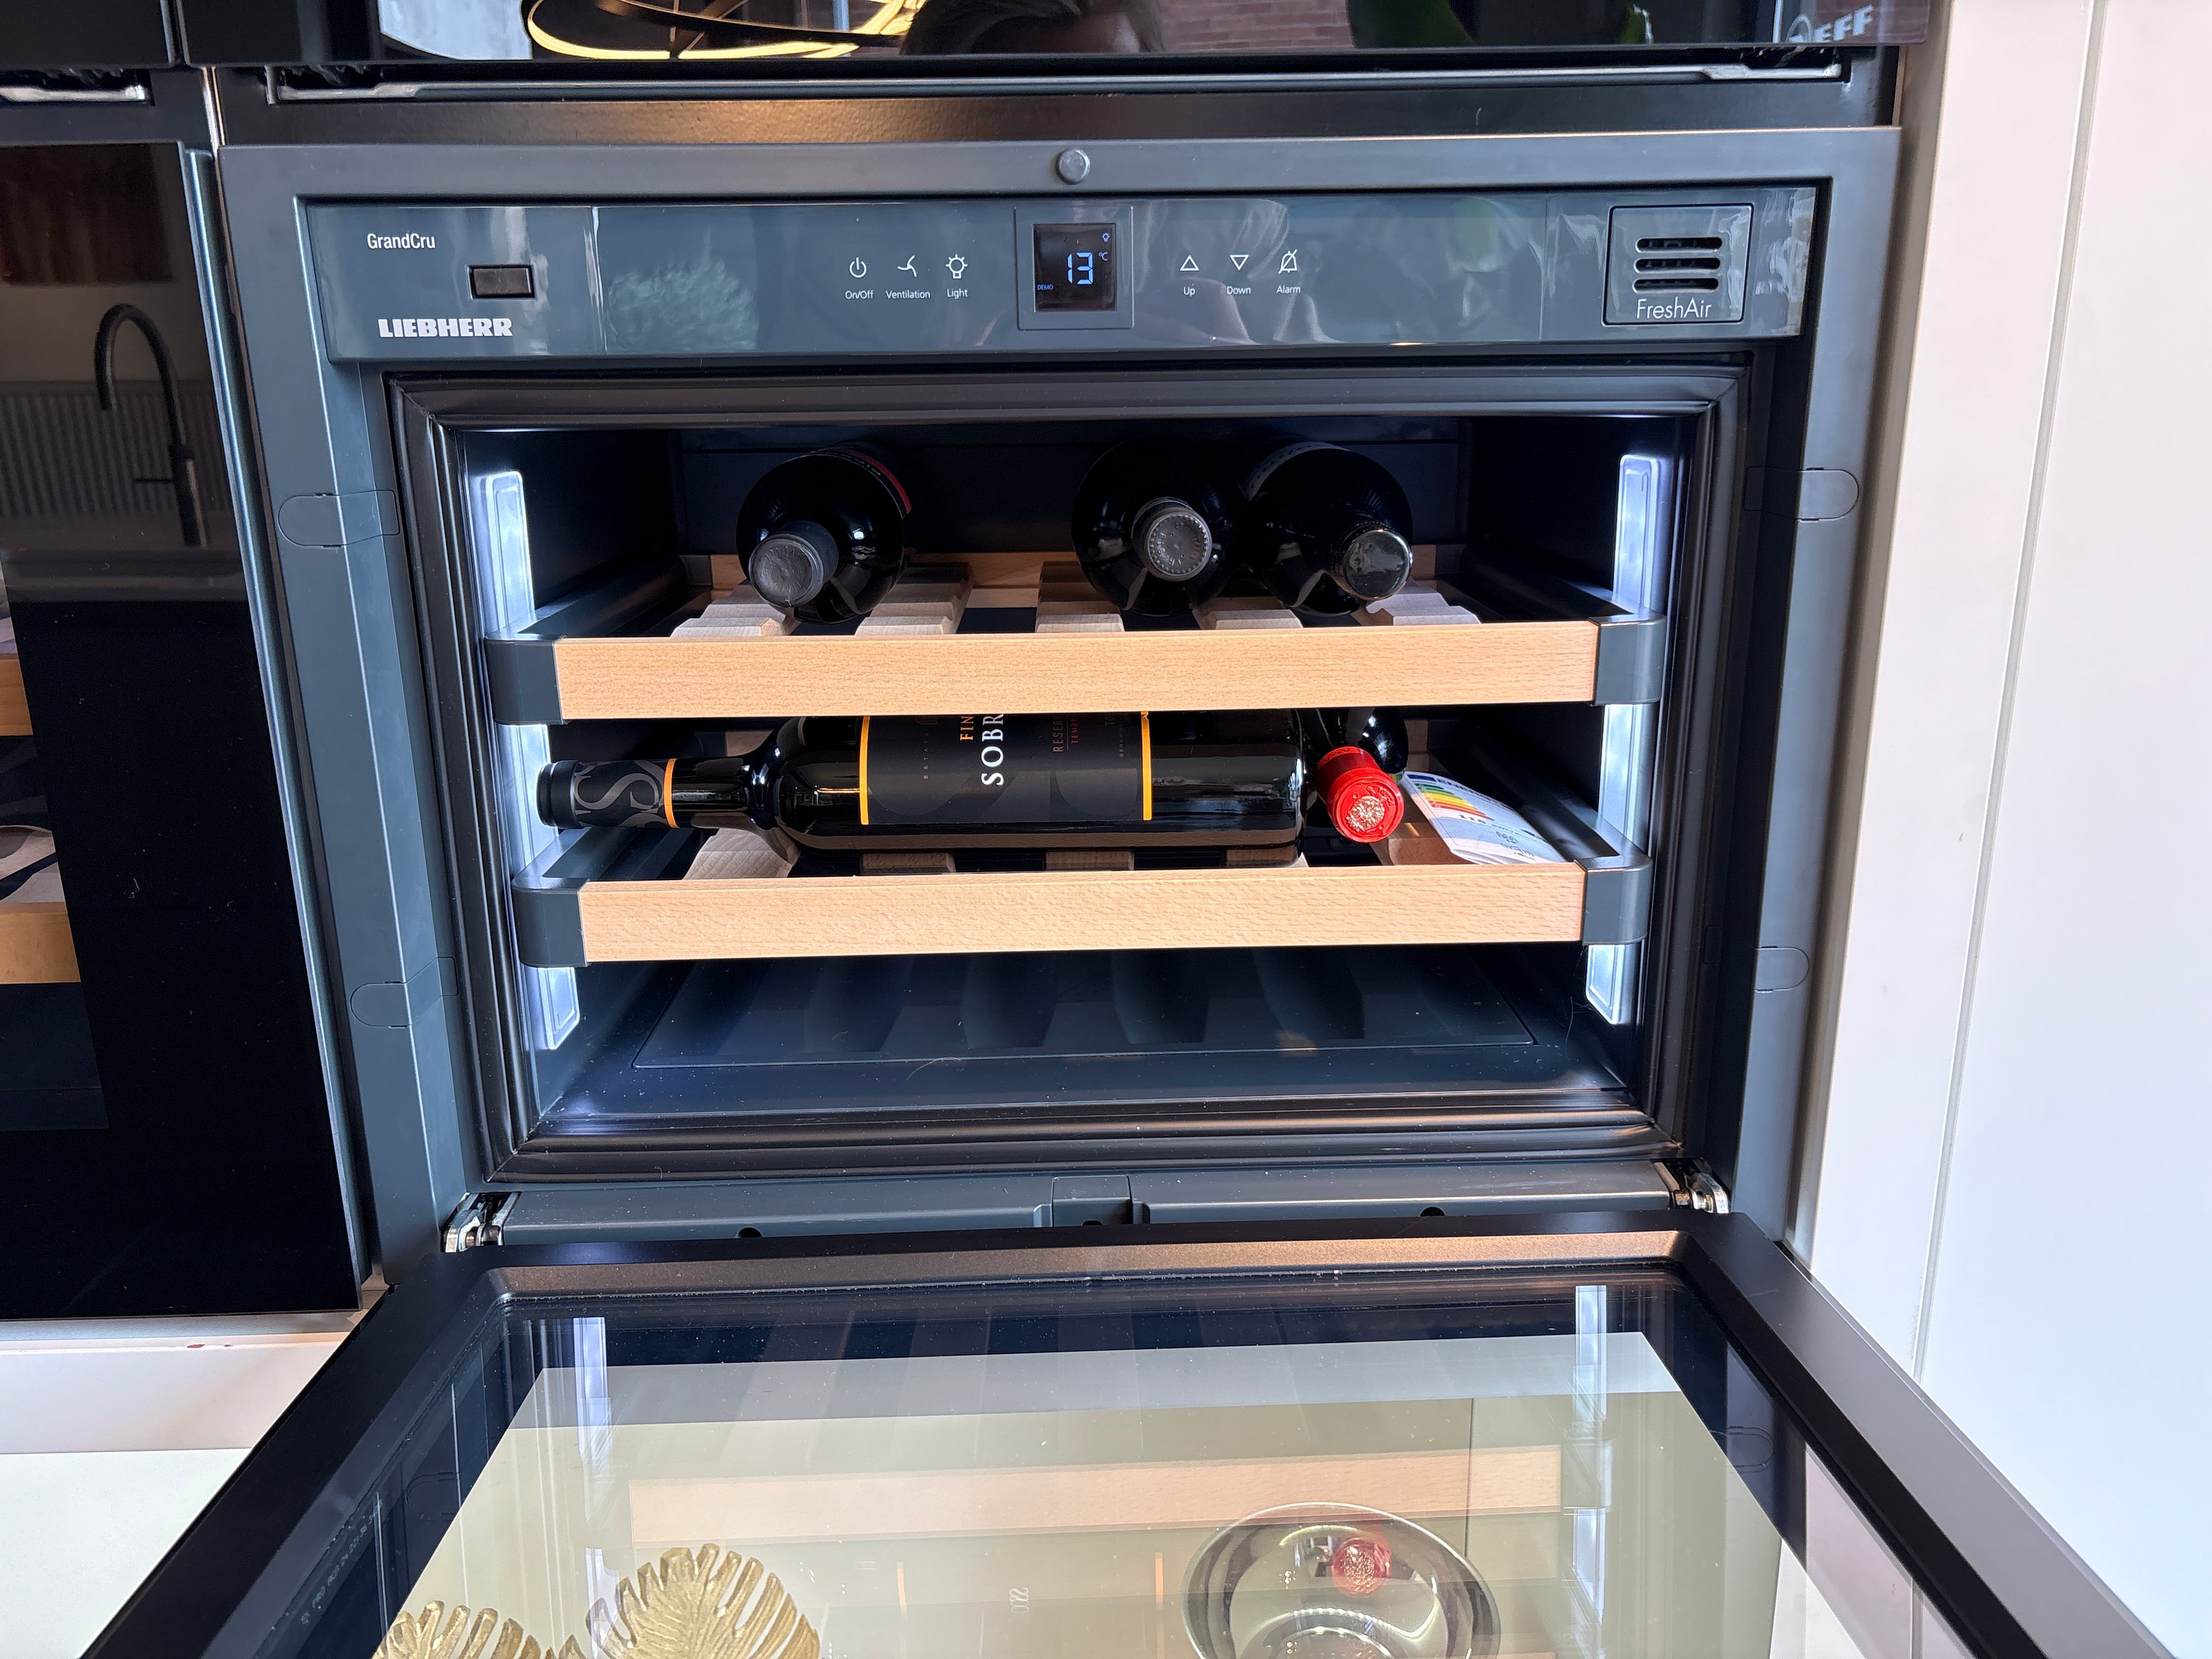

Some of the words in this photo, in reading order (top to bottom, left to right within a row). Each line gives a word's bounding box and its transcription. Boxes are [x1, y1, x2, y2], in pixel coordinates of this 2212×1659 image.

[367, 233, 436, 249] GrandCru
[1067, 252, 1093, 285] 13
[845, 290, 874, 300] On/Off
[885, 290, 930, 299] Ventilation
[947, 288, 968, 299] Light
[1183, 286, 1195, 297] Up
[1227, 286, 1251, 295] Down
[1276, 285, 1301, 294] Alarm
[1637, 296, 1712, 319] FreshAir
[377, 318, 514, 338] LIEBHERR
[981, 713, 1003, 786] SOBR
